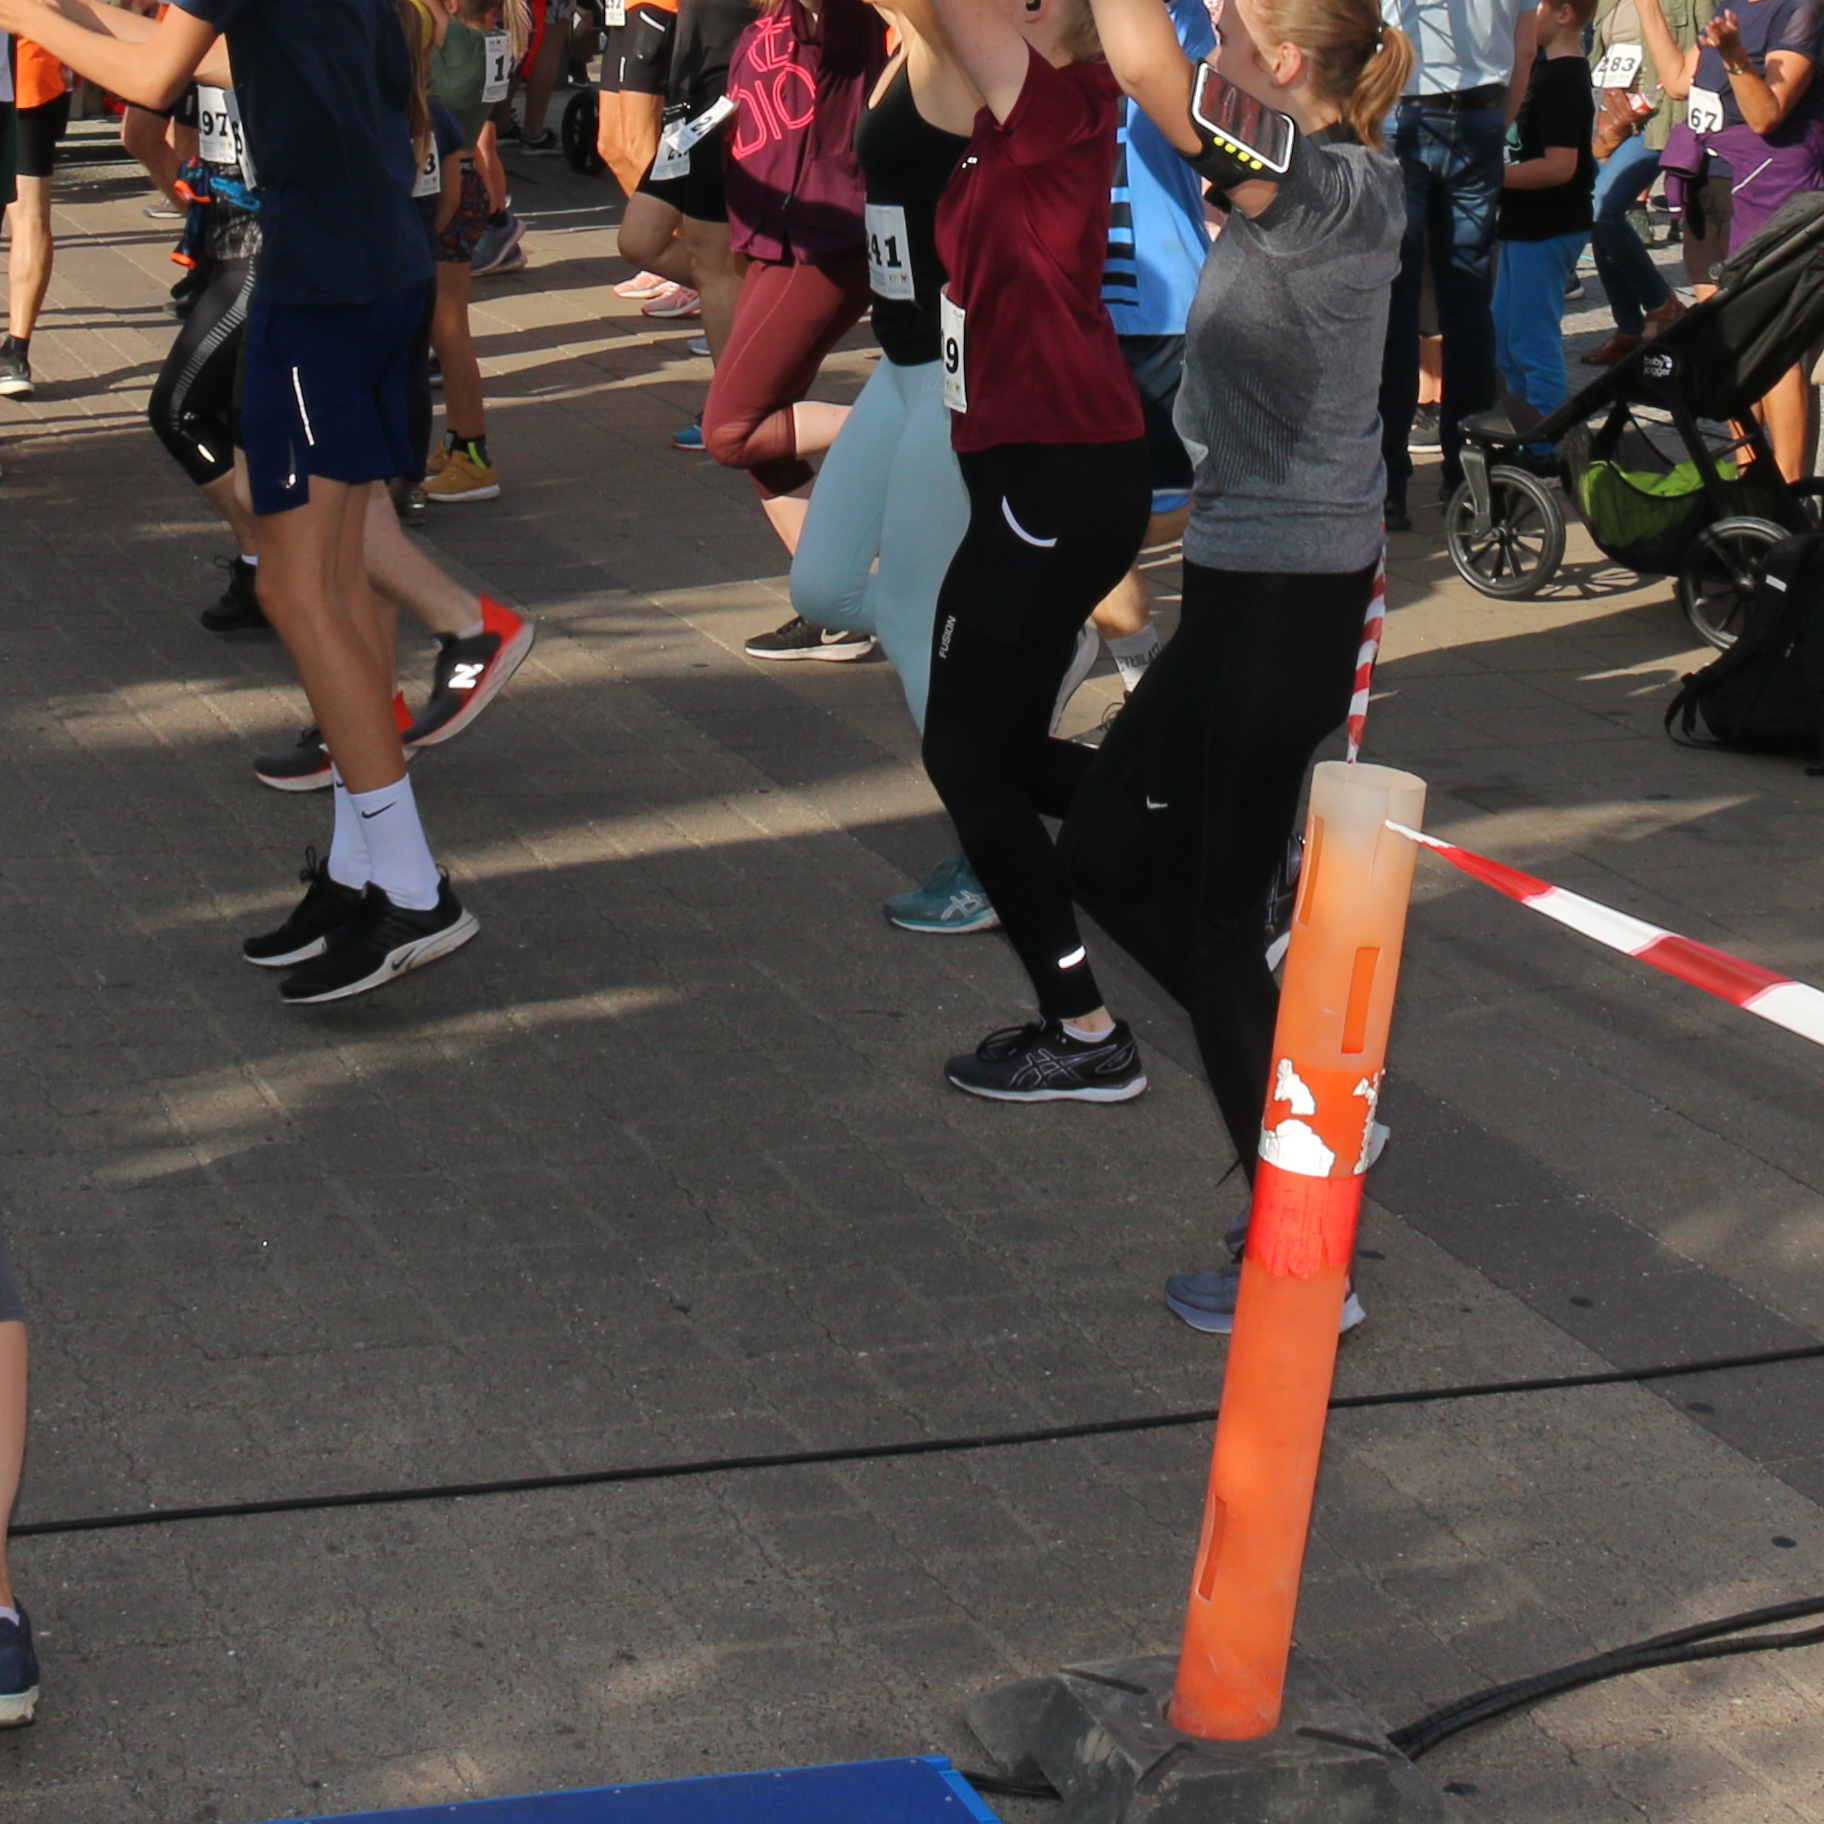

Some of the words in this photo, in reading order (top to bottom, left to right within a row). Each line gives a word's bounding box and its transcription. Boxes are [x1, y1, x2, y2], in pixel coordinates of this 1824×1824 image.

[1599, 56, 1636, 72] 283
[199, 110, 228, 136] 97
[1691, 107, 1718, 131] 67
[868, 233, 903, 268] 41
[938, 615, 957, 659] FUSION
